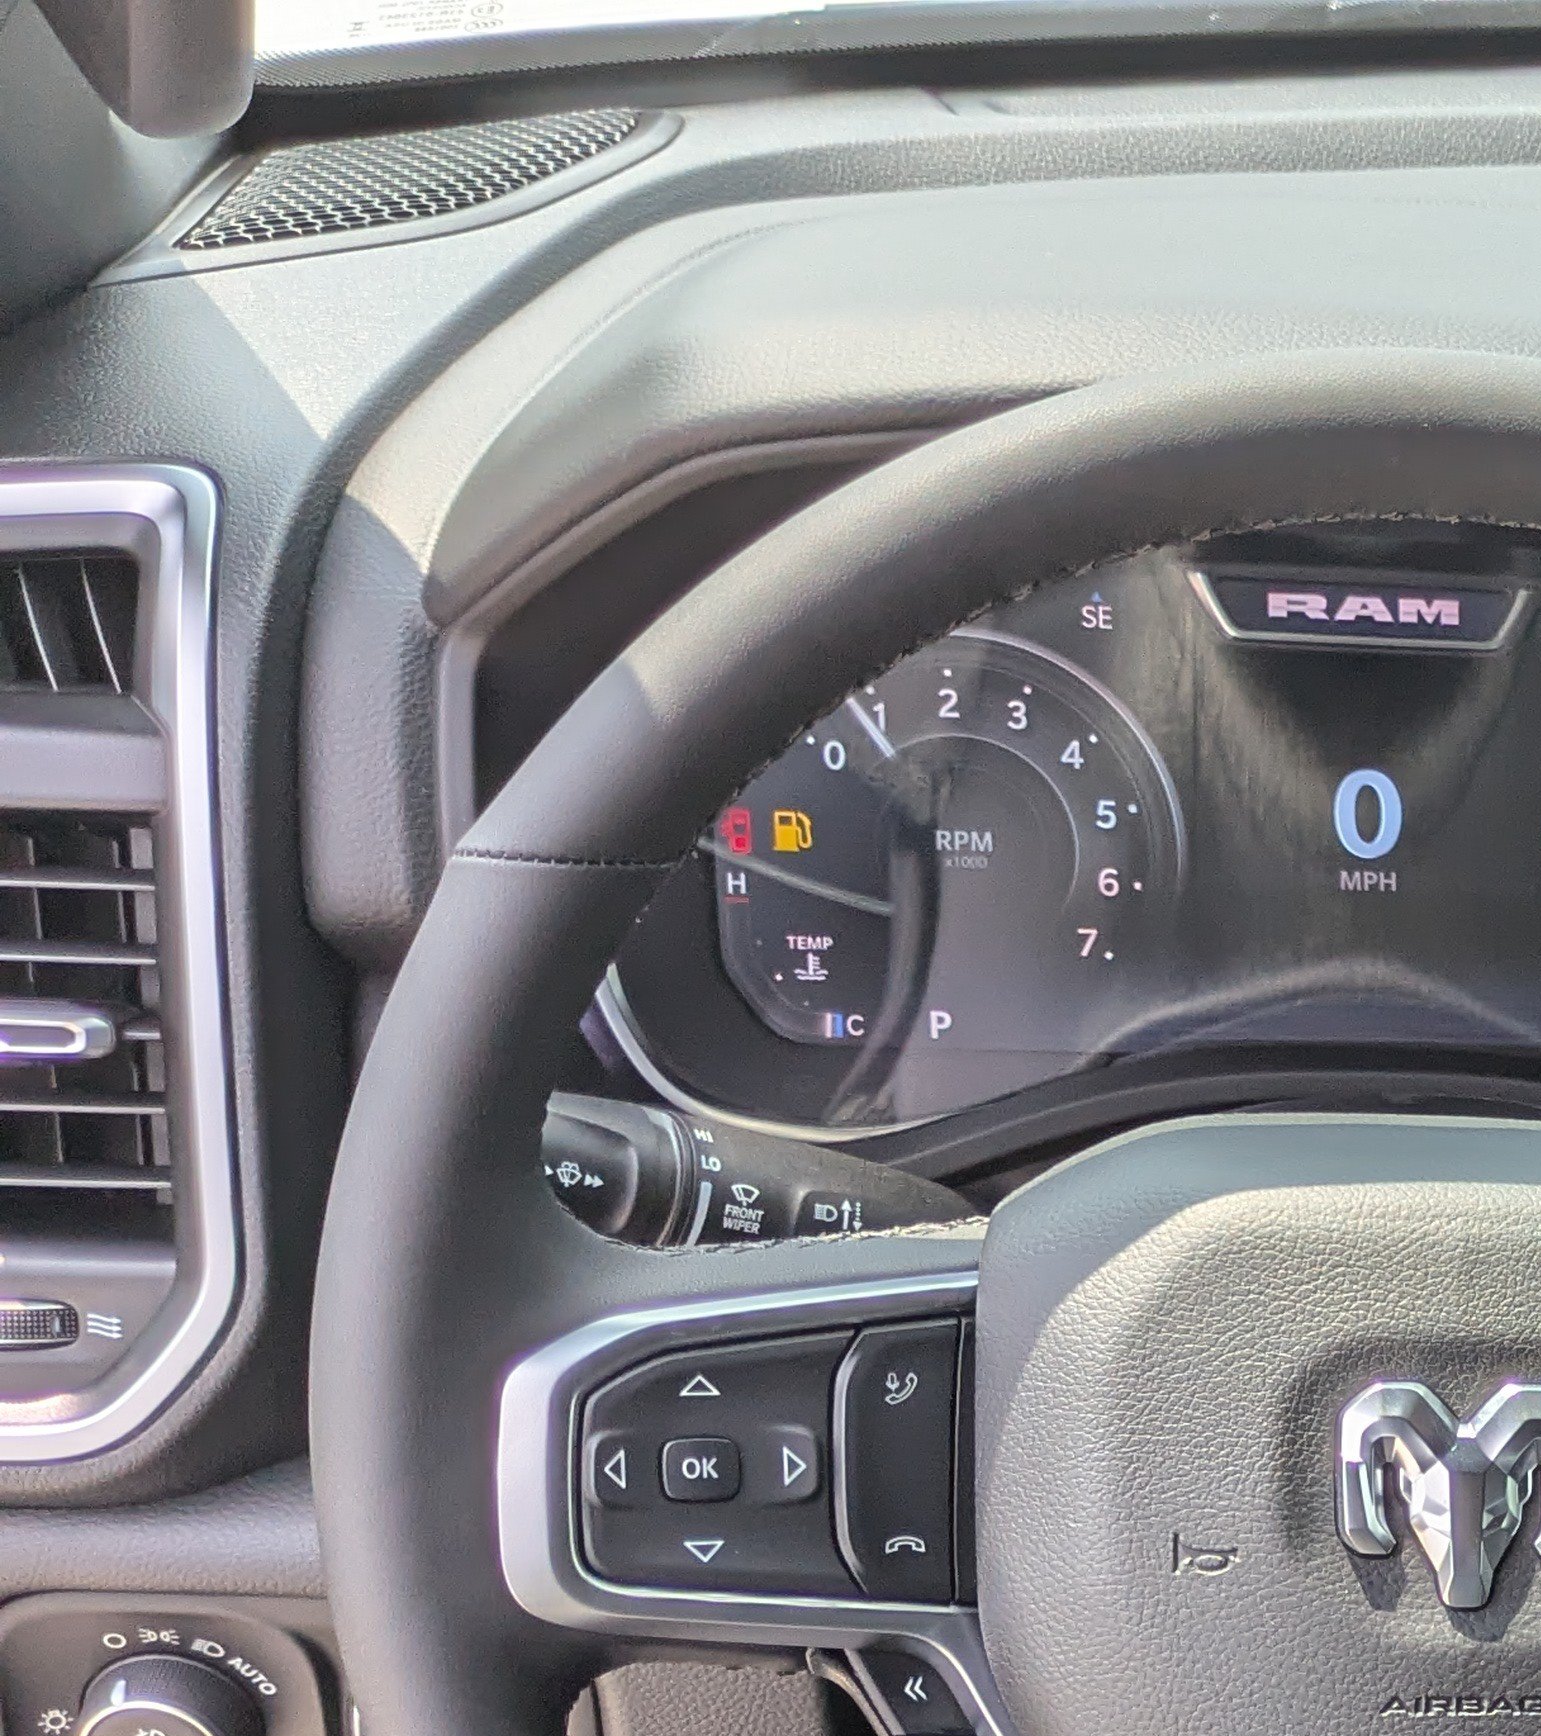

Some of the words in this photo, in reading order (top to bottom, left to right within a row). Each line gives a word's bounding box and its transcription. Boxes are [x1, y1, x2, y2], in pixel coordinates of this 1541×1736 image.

[1081, 605, 1113, 630] SE
[1267, 591, 1459, 626] RAM
[938, 688, 960, 718] 2
[1007, 700, 1028, 730] 3
[823, 740, 847, 771] 0
[1061, 740, 1085, 769] 4
[1096, 800, 1118, 829] 5
[1334, 769, 1402, 858] 0
[935, 829, 994, 852] RPM
[727, 872, 747, 894] H
[1098, 869, 1119, 896] 6
[1339, 871, 1397, 893] MPH
[786, 936, 833, 950] TEMP
[1077, 929, 1099, 957] 7
[846, 1013, 864, 1037] C
[929, 1011, 952, 1039] P
[701, 1154, 721, 1172] LO
[722, 1217, 761, 1235] WIPER
[724, 1204, 765, 1223] FRONT
[681, 1457, 720, 1480] OK
[227, 1656, 277, 1695] AUTO
